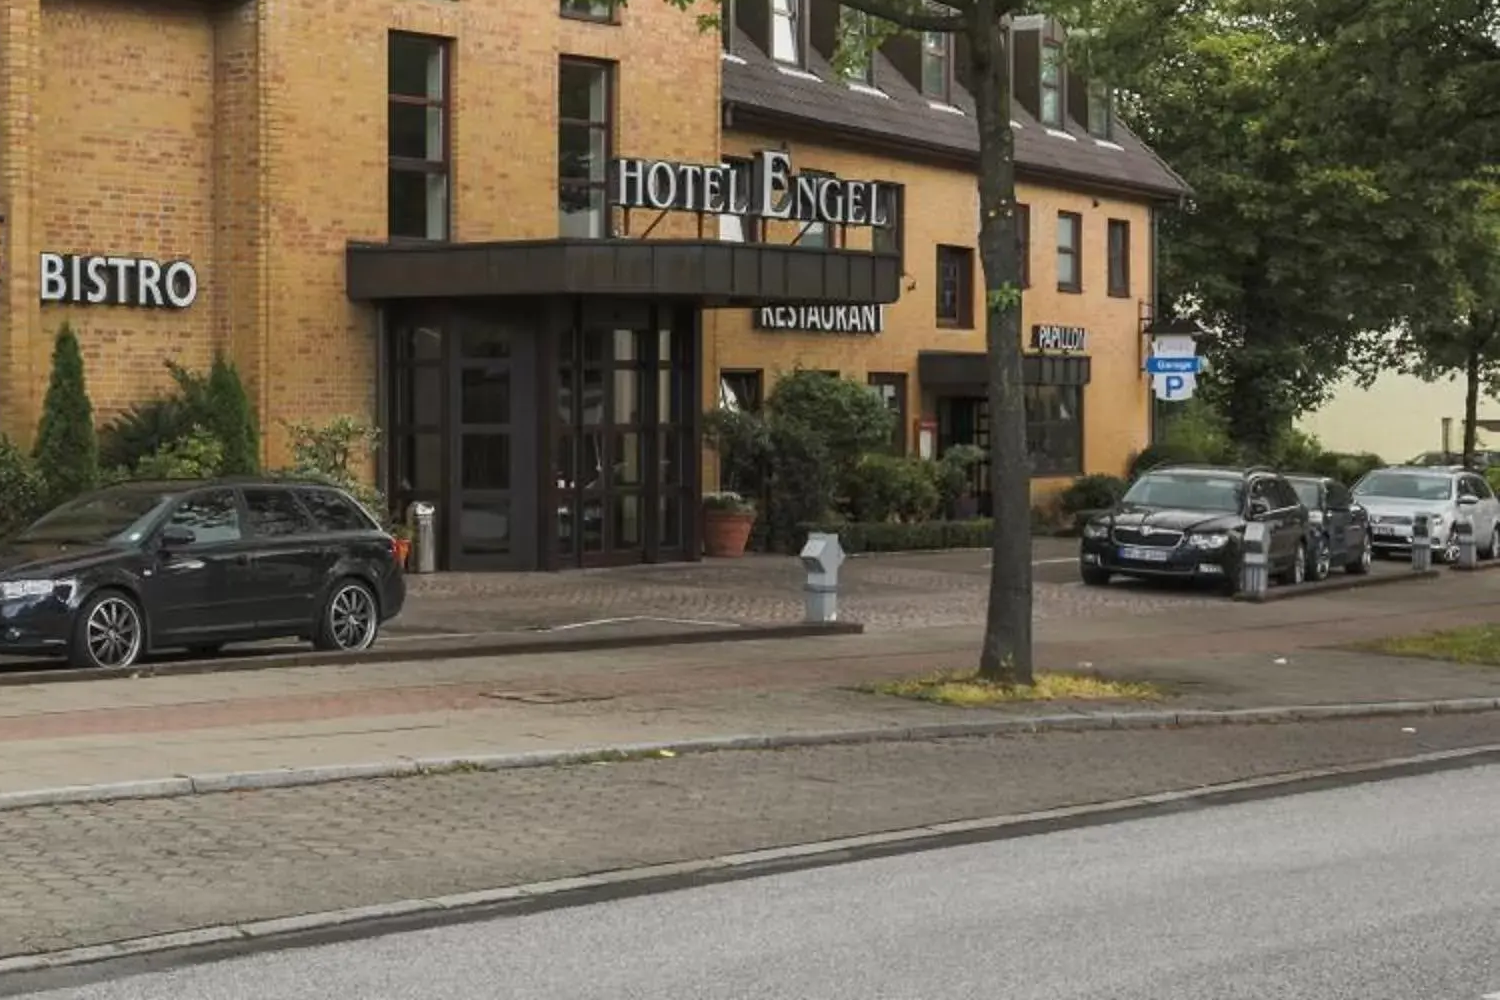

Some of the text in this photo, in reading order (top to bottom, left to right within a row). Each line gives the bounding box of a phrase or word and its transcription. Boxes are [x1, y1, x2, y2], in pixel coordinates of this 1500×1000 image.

[619, 151, 887, 225] HOTEL ENGEL
[40, 253, 198, 307] BISTRO
[1040, 326, 1088, 350] PAPILLON
[1165, 376, 1184, 398] P
